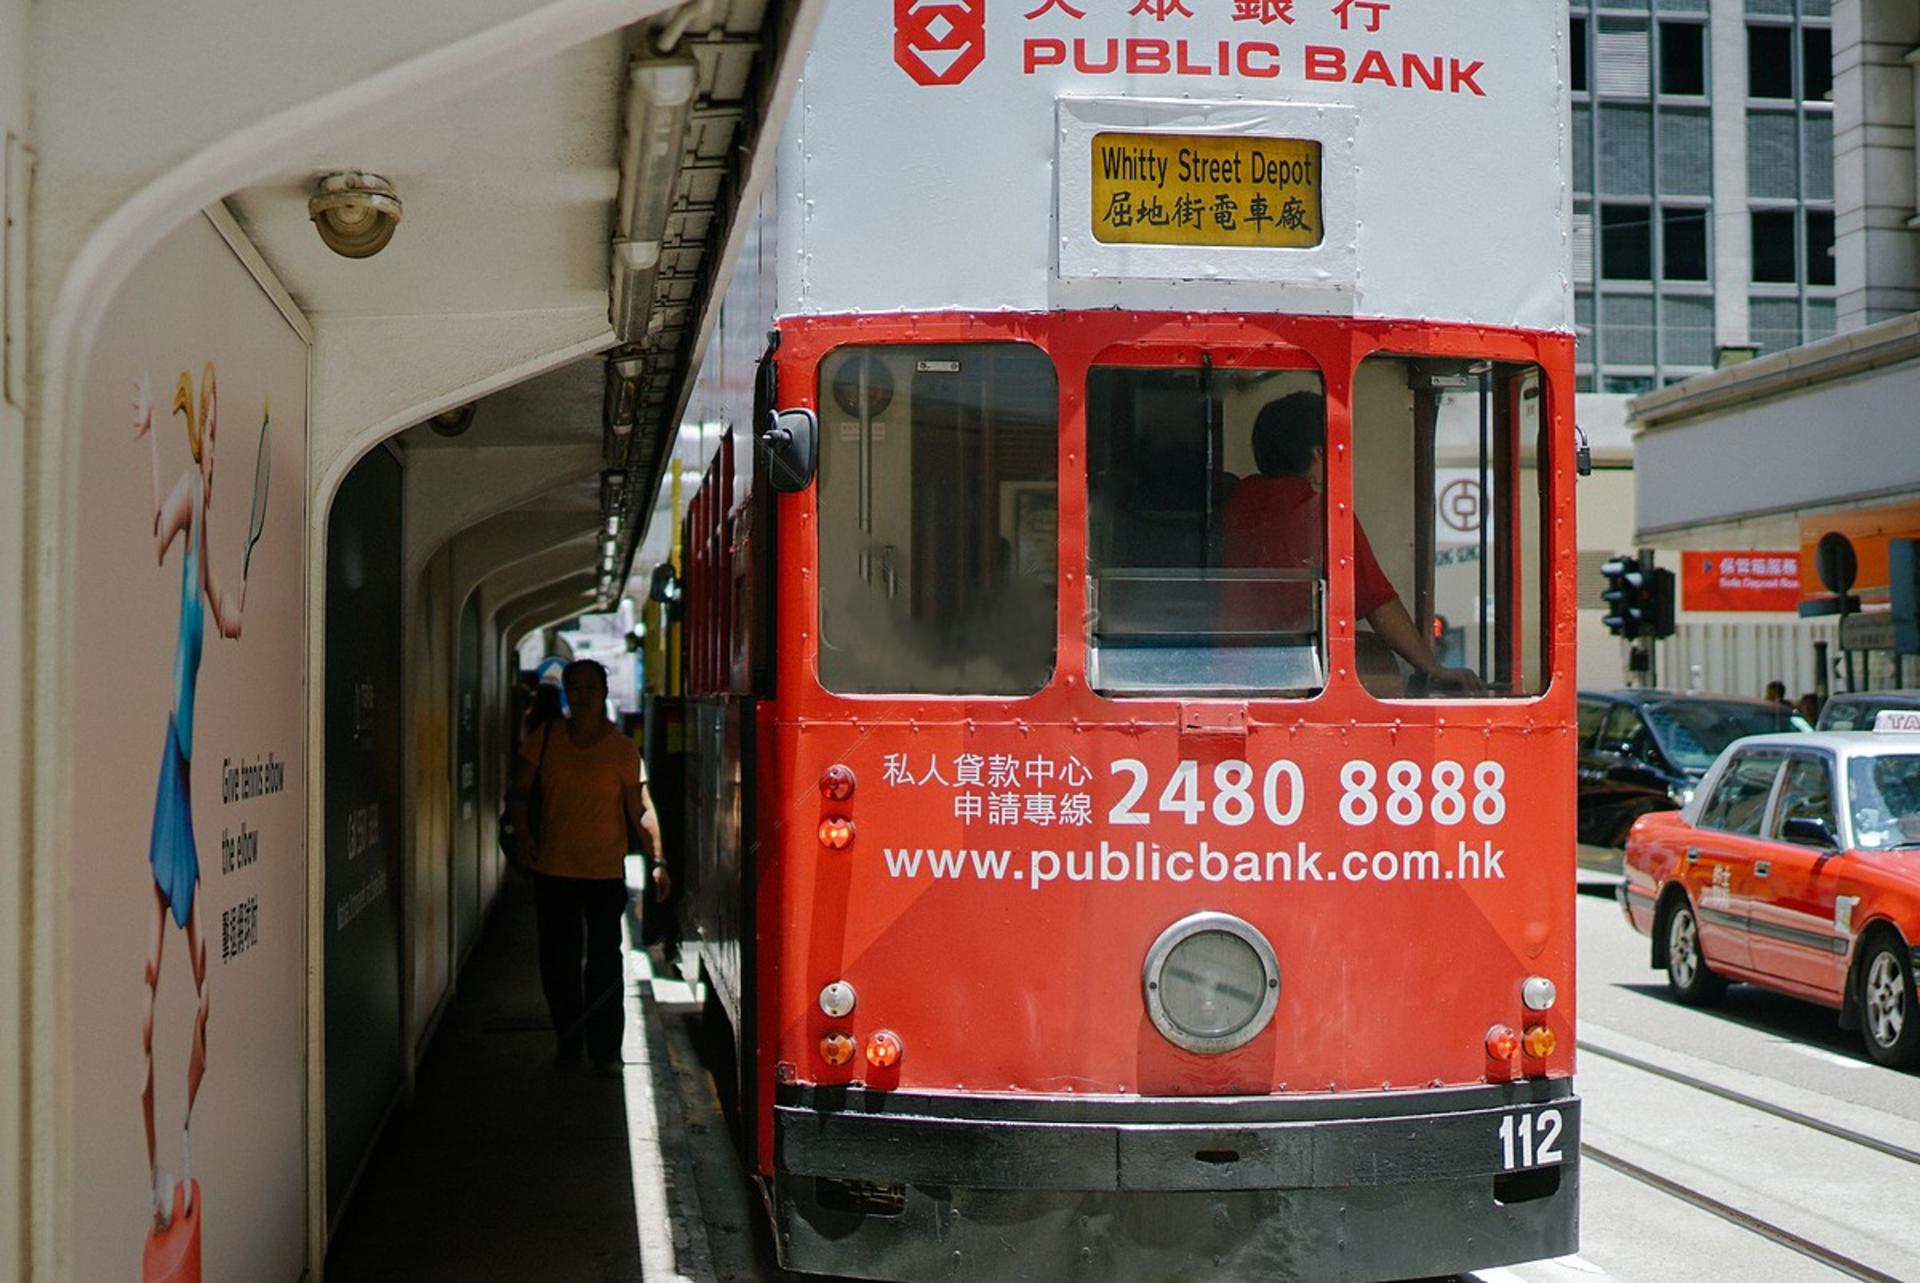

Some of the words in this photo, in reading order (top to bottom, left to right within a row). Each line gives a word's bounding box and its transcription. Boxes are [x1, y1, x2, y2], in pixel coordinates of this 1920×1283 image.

[1023, 38, 1281, 78] PUBLIC
[1304, 44, 1487, 97] BANK
[1101, 146, 1168, 188] Whitty
[1178, 147, 1242, 184] Street
[1251, 150, 1313, 190] Depot
[1102, 191, 1313, 233] 屈地街電車廠
[882, 752, 1094, 788] 私人貸款中心
[1108, 758, 1305, 826] 2480
[1338, 759, 1507, 826] 8888
[953, 790, 1093, 826] 申請專線
[221, 827, 235, 876] the
[883, 840, 1506, 890] www.publicbank.com.hk
[1498, 1109, 1563, 1171] 112
